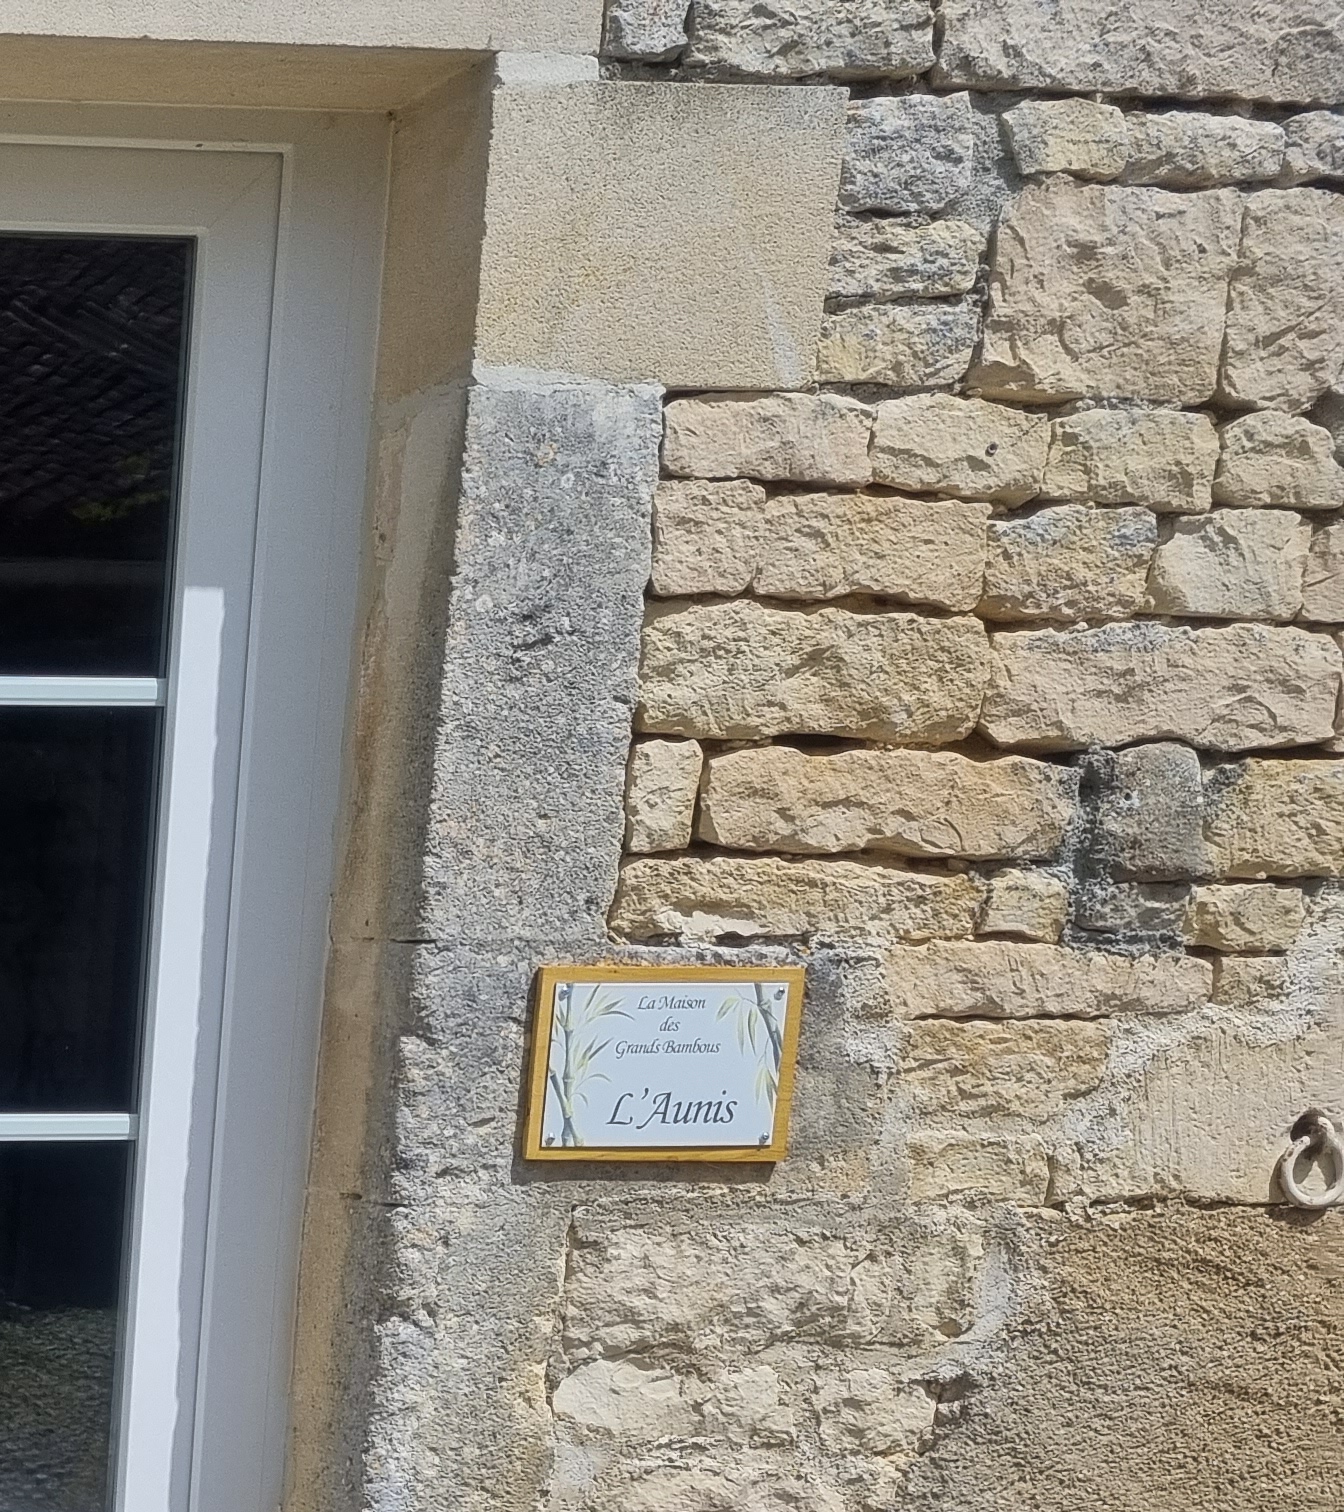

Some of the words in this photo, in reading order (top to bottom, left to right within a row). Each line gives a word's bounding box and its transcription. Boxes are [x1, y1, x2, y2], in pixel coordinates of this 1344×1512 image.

[638, 995, 656, 1010] La
[658, 995, 707, 1010] Maison
[659, 1016, 680, 1032] des
[615, 1038, 661, 1059] Grands
[662, 1037, 721, 1054] Bambous
